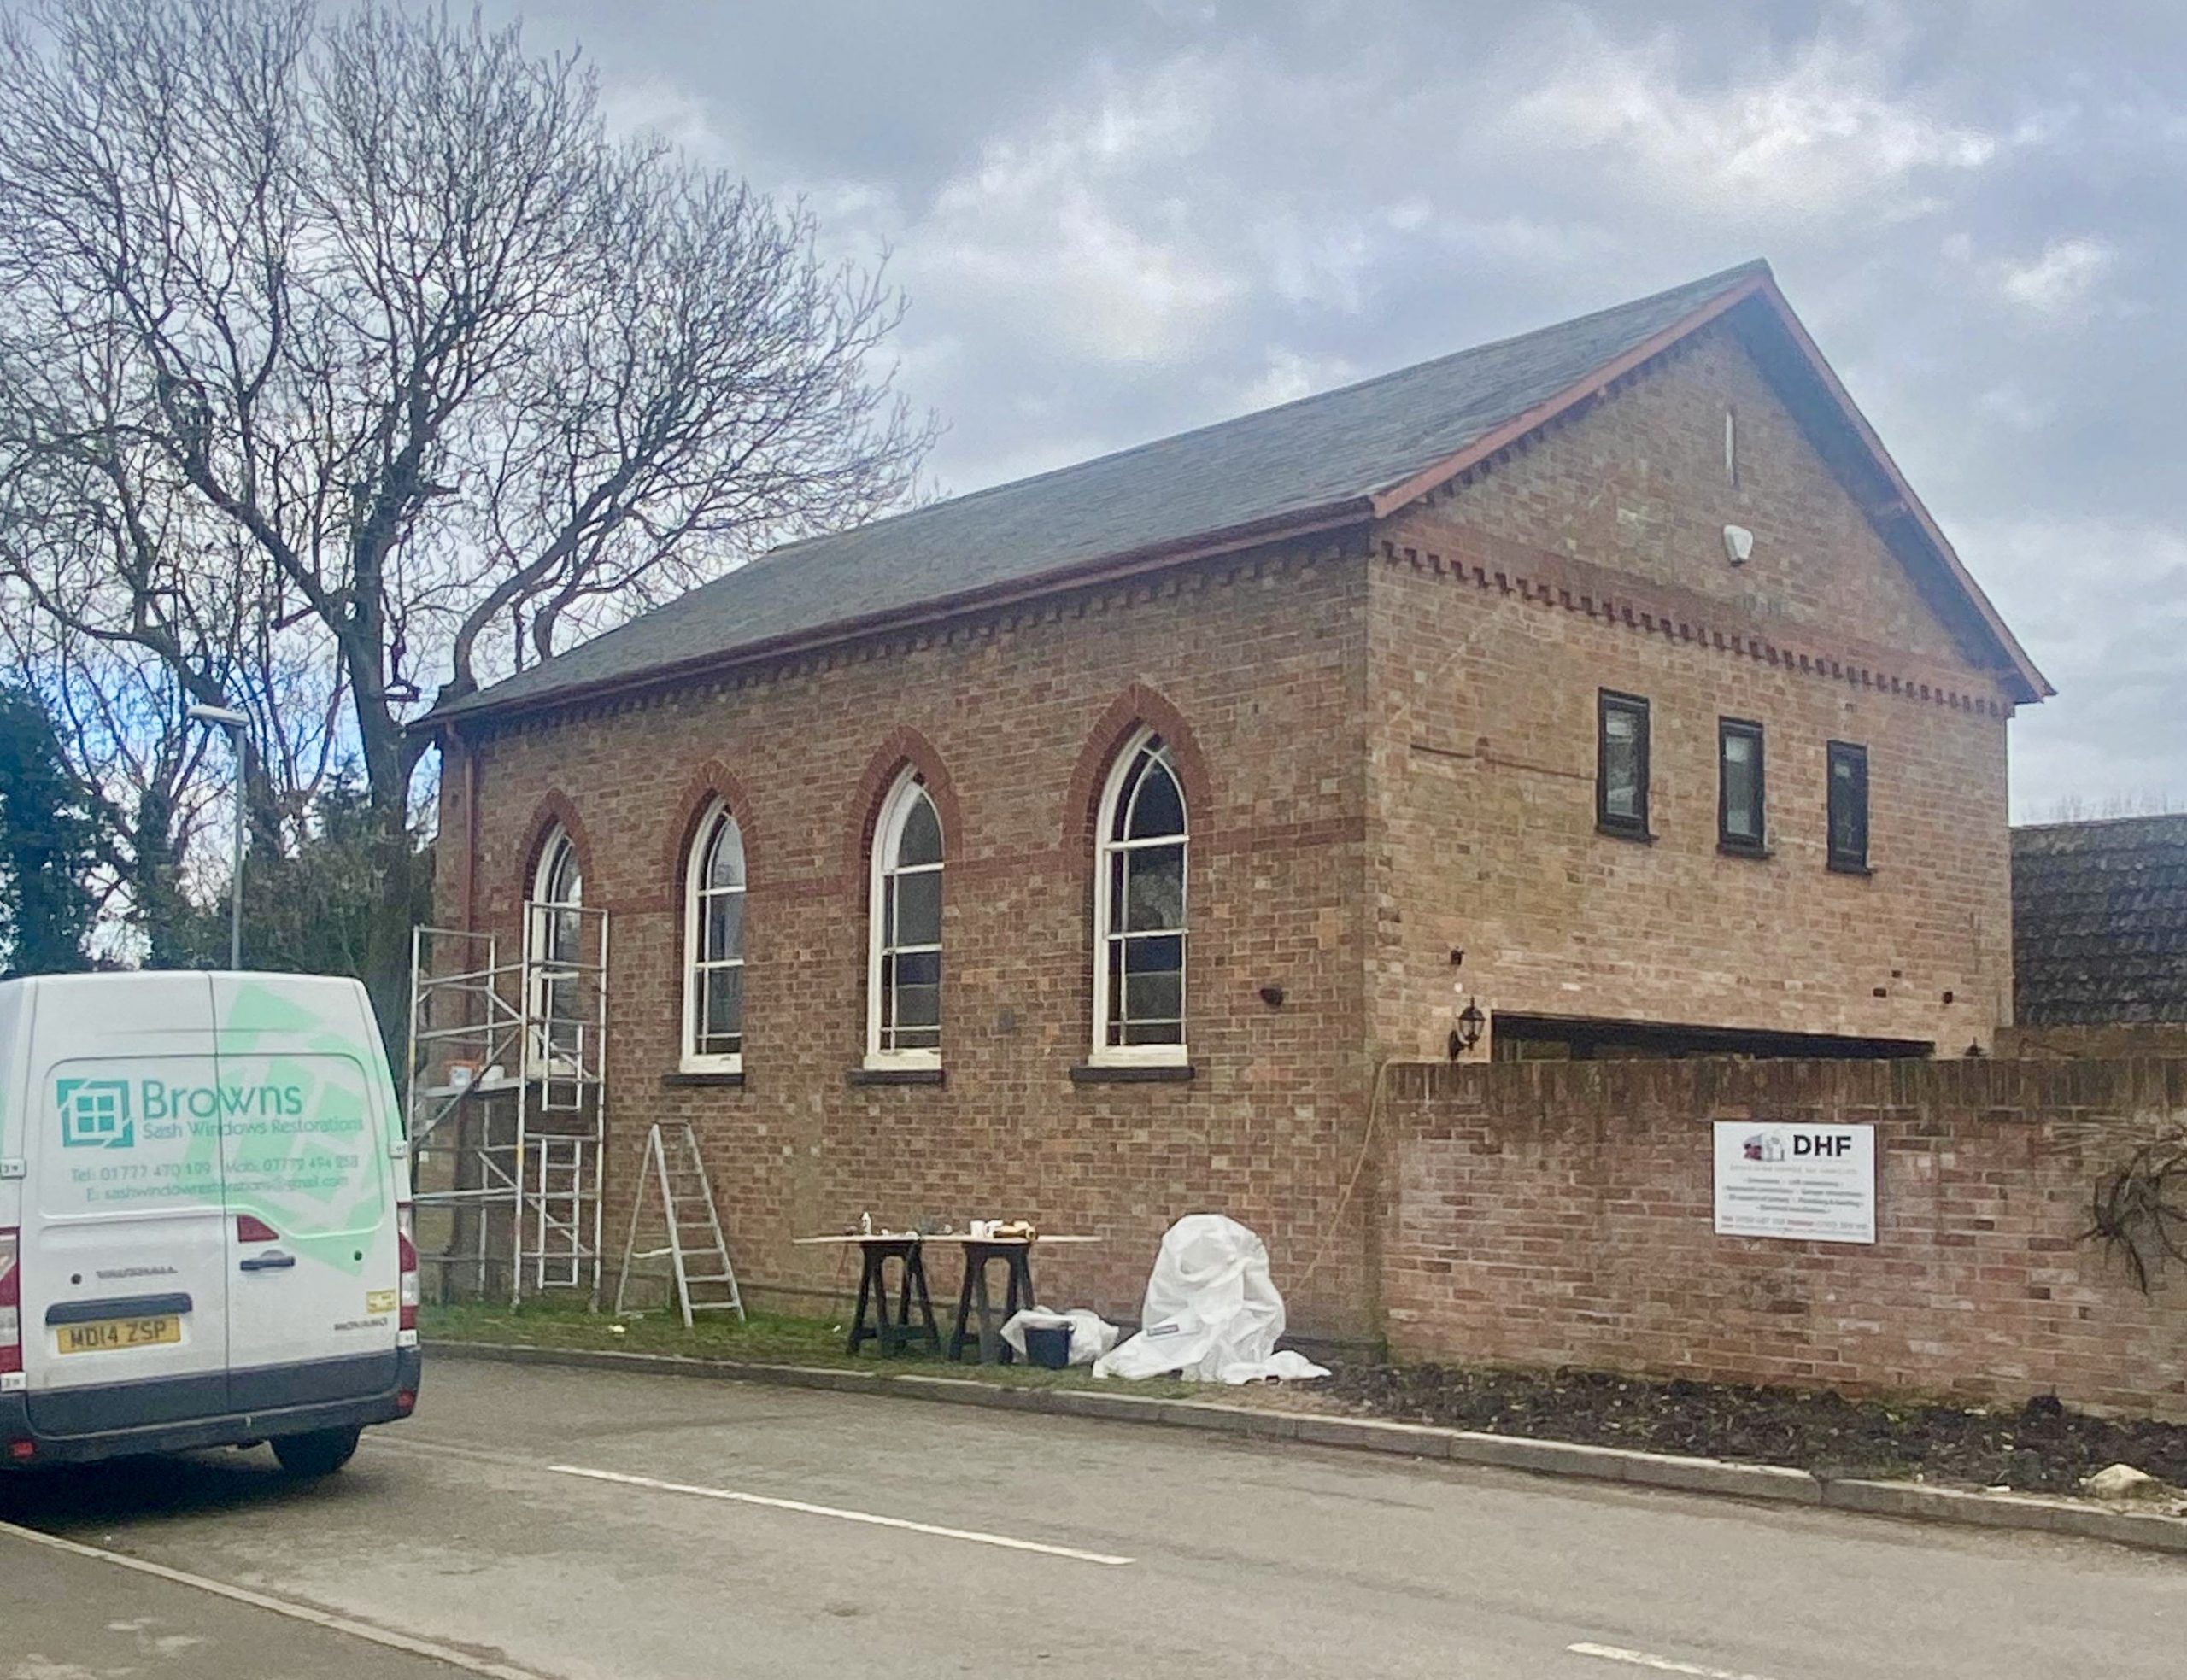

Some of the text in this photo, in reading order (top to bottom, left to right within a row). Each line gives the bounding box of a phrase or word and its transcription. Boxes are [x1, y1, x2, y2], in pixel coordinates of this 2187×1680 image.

[142, 1080, 302, 1120] Browns
[143, 1121, 183, 1139] Sash
[187, 1120, 267, 1138] Windows
[1793, 1134, 1852, 1156] DHF
[70, 1320, 167, 1349] MD14 ZSP
